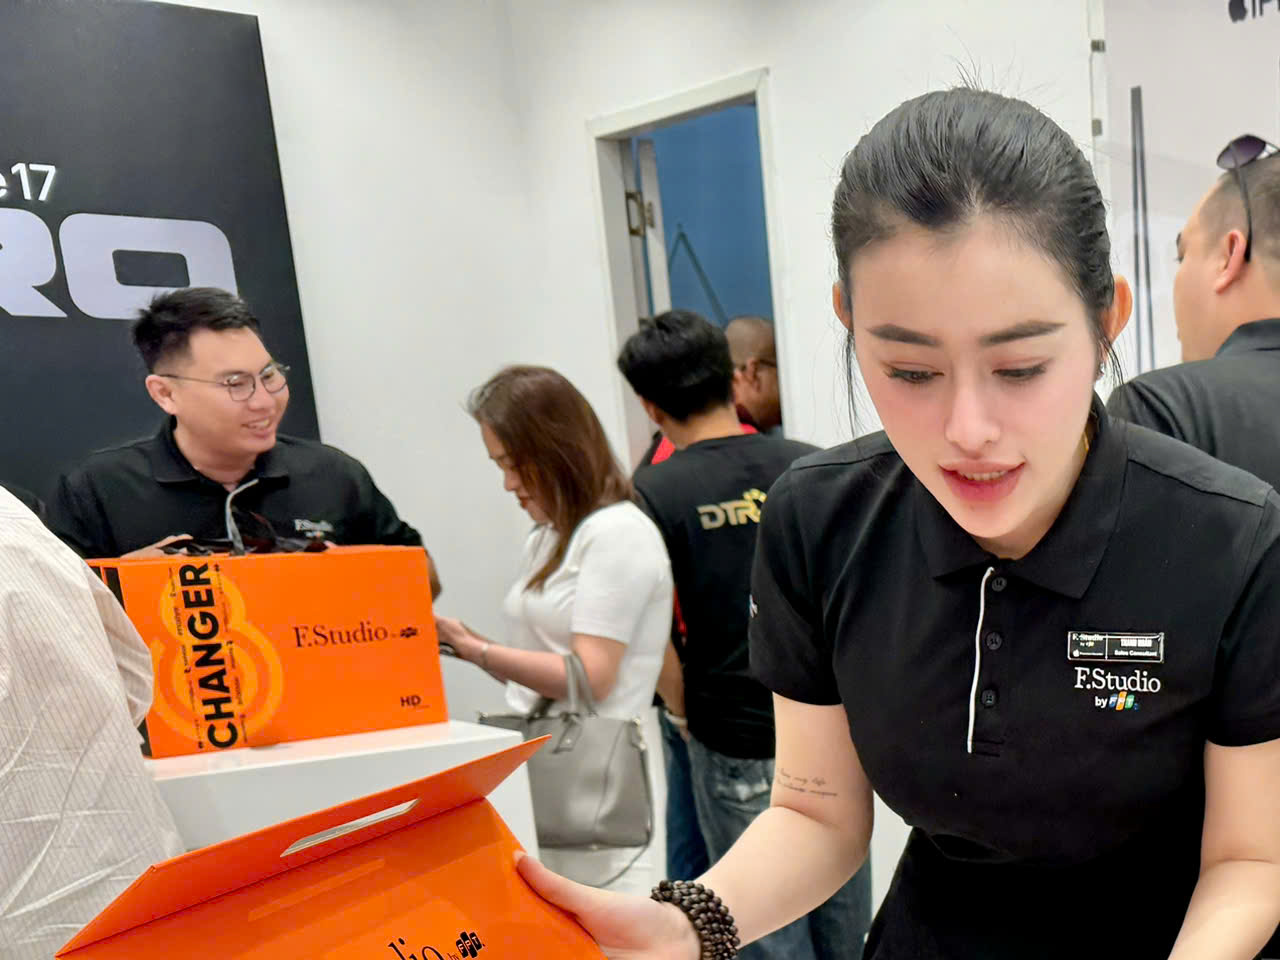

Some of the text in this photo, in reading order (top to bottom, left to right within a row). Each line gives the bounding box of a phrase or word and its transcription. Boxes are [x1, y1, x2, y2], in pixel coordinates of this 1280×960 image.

[293, 621, 389, 648] F.Studio
[179, 563, 239, 749] CHANGER
[1074, 667, 1161, 693] F.Studio
[1095, 696, 1108, 708] by
[456, 931, 486, 959] FPT
